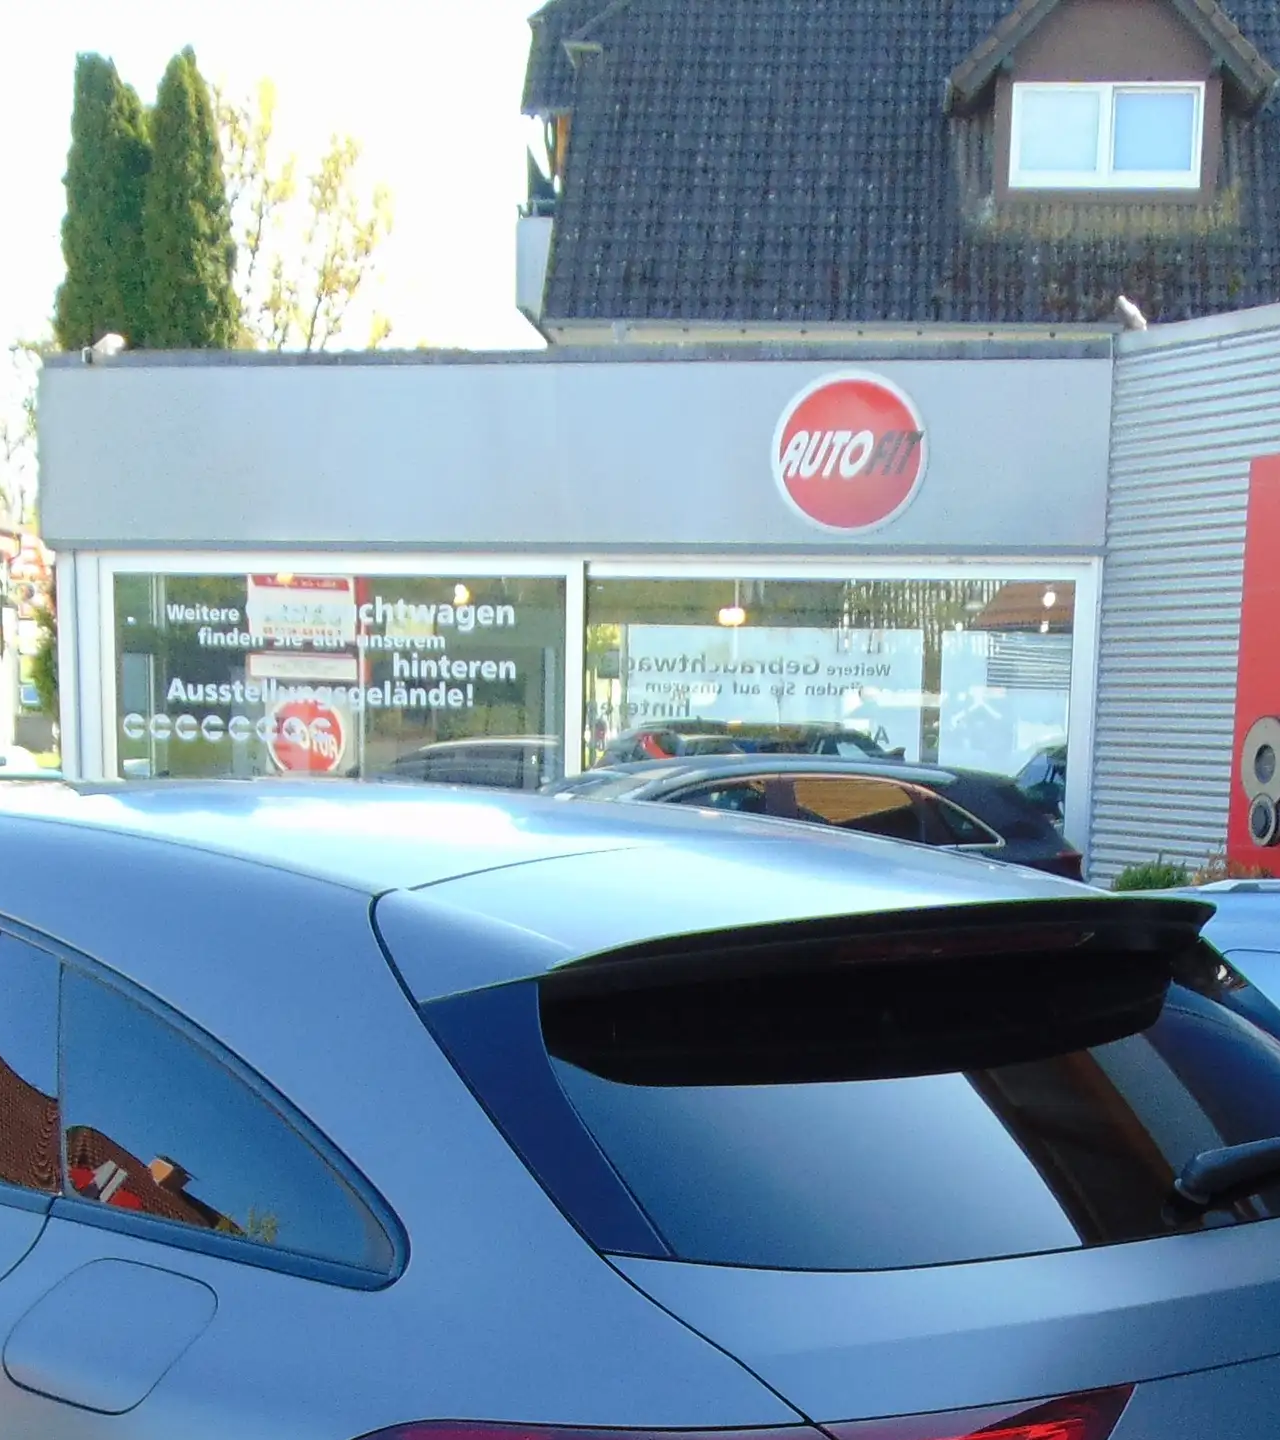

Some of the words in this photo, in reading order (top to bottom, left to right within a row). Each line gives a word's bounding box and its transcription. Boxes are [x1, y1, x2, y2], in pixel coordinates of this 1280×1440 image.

[166, 603, 240, 622] Weitere
[197, 627, 264, 647] finden
[393, 652, 517, 680] hinteren
